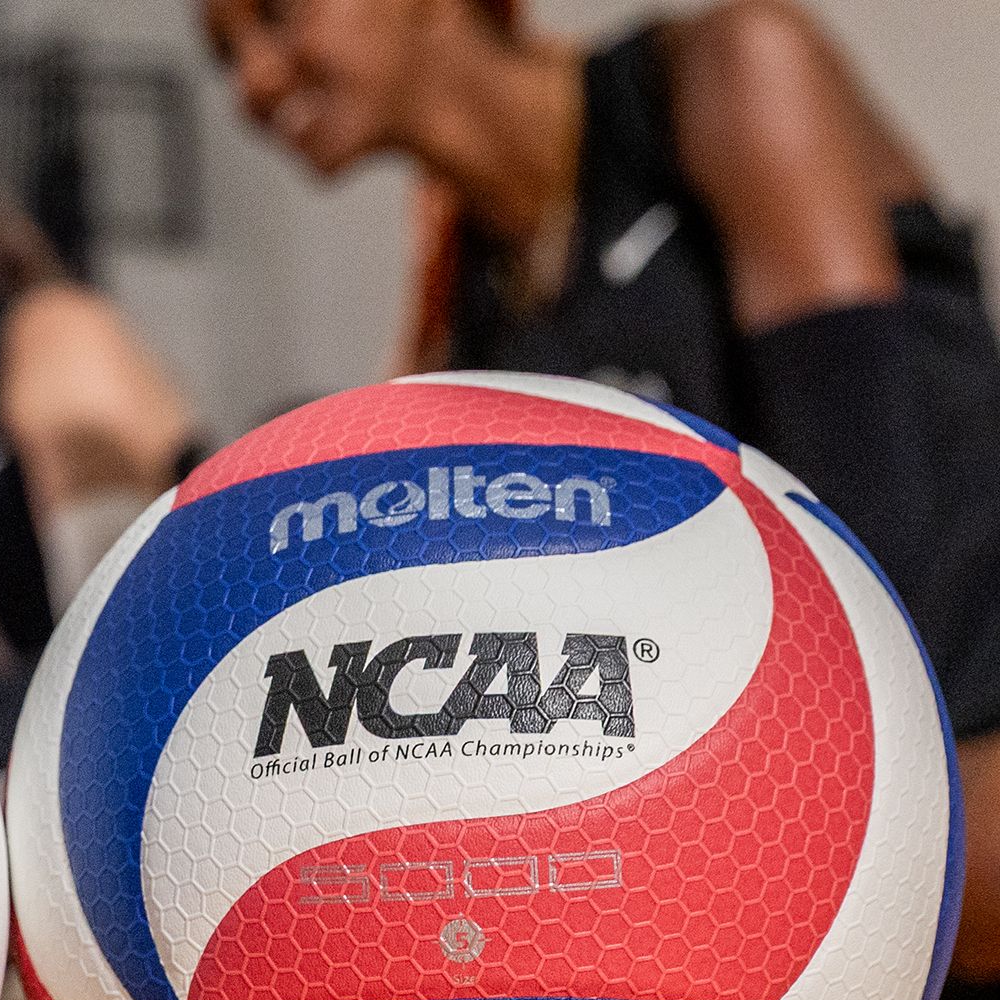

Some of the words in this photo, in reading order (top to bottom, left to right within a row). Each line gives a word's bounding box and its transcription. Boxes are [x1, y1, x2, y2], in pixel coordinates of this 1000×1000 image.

[250, 750, 317, 780] Official
[324, 747, 361, 768] Ball
[369, 742, 389, 763] of
[396, 744, 453, 760] NCAA
[301, 849, 622, 904] 5000
